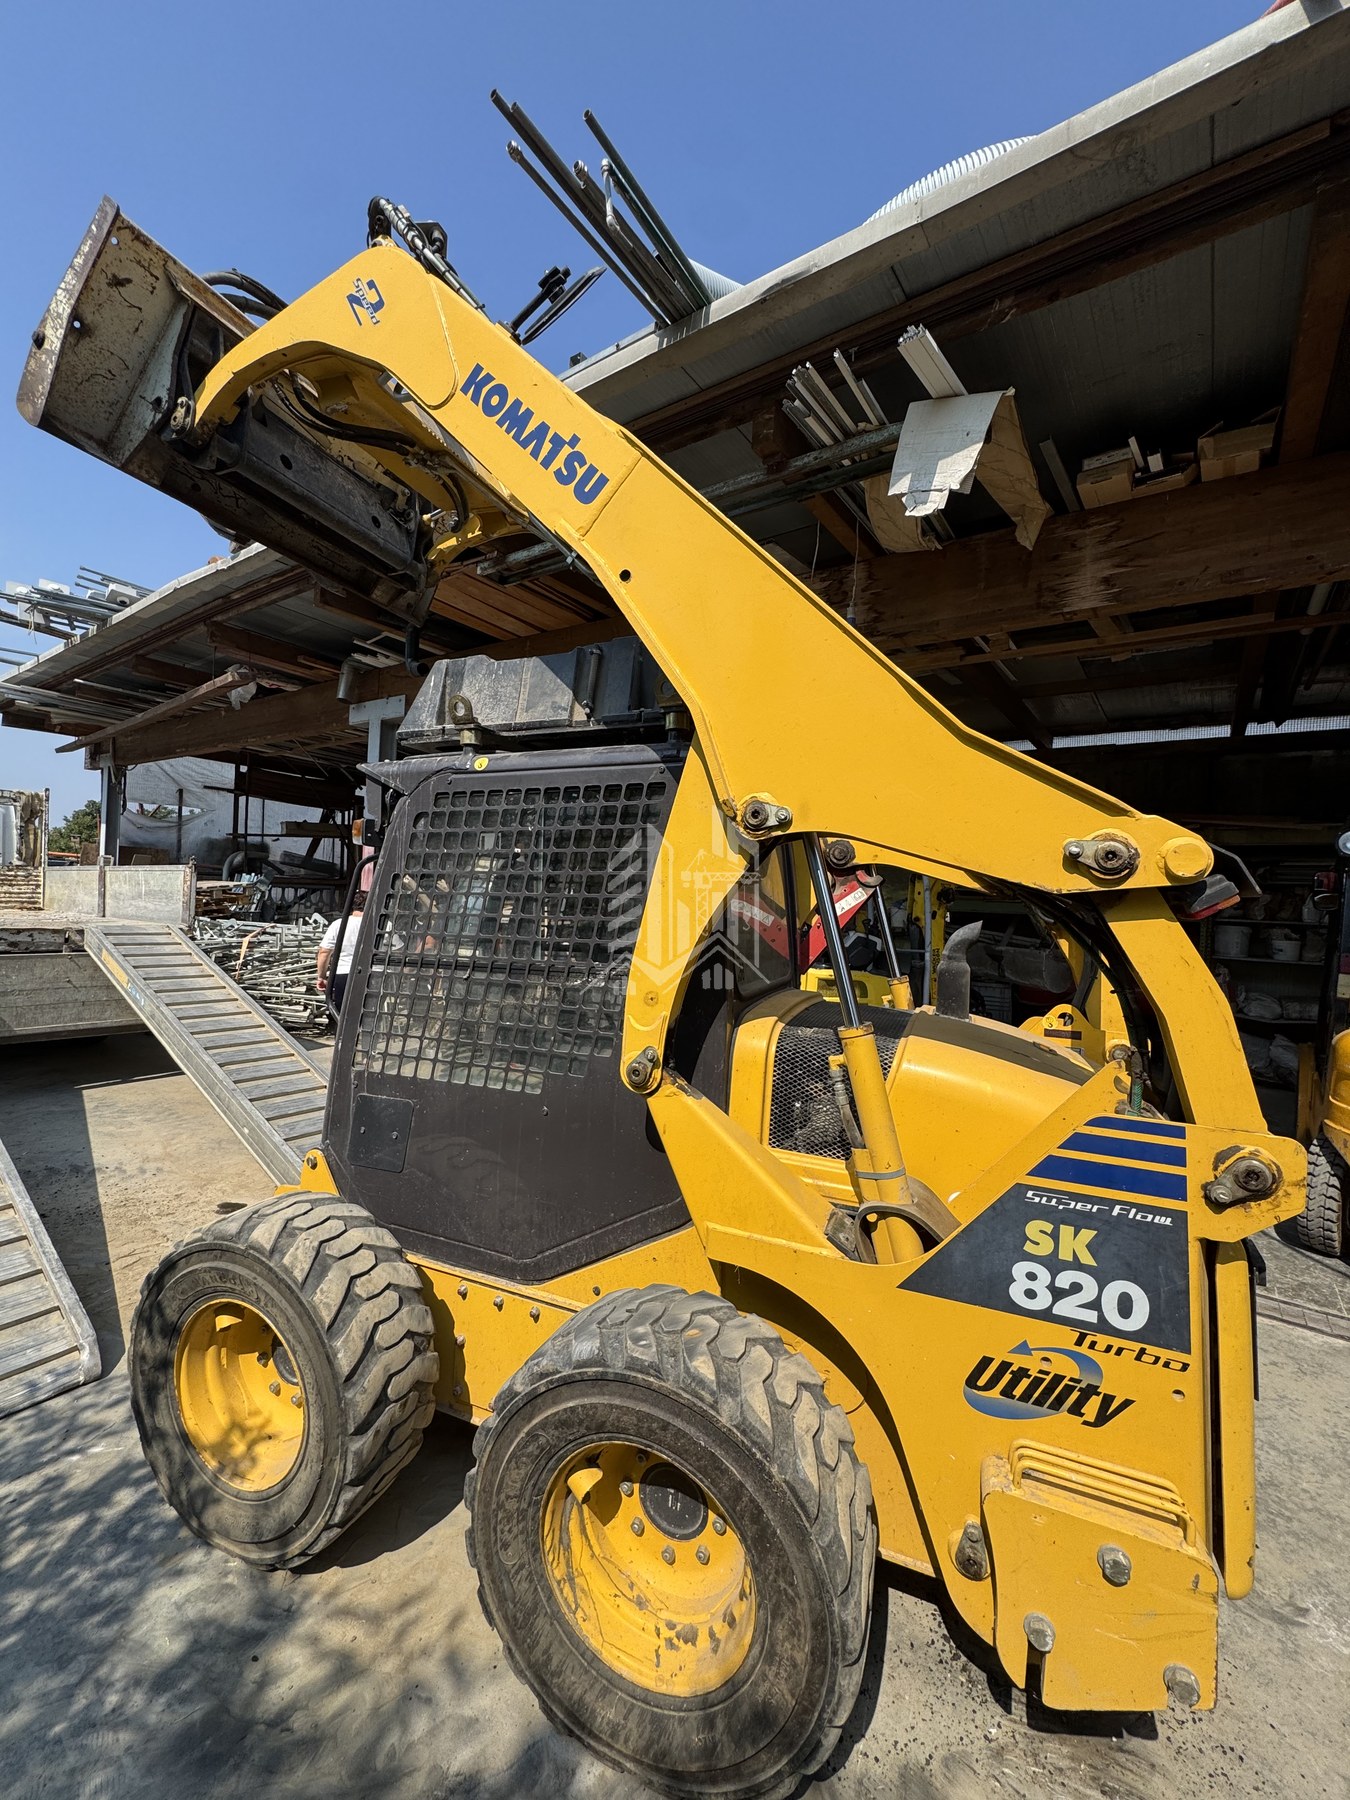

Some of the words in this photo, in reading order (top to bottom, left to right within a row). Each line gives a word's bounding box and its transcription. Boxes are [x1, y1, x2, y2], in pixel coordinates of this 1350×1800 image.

[460, 362, 610, 505] KOMATSU
[1024, 1190, 1109, 1213] Super
[1111, 1204, 1173, 1226] Flow
[1023, 1219, 1098, 1267] SK
[1008, 1260, 1150, 1332] 820
[1070, 1329, 1190, 1373] Turbo
[964, 1355, 1136, 1428] Utility
